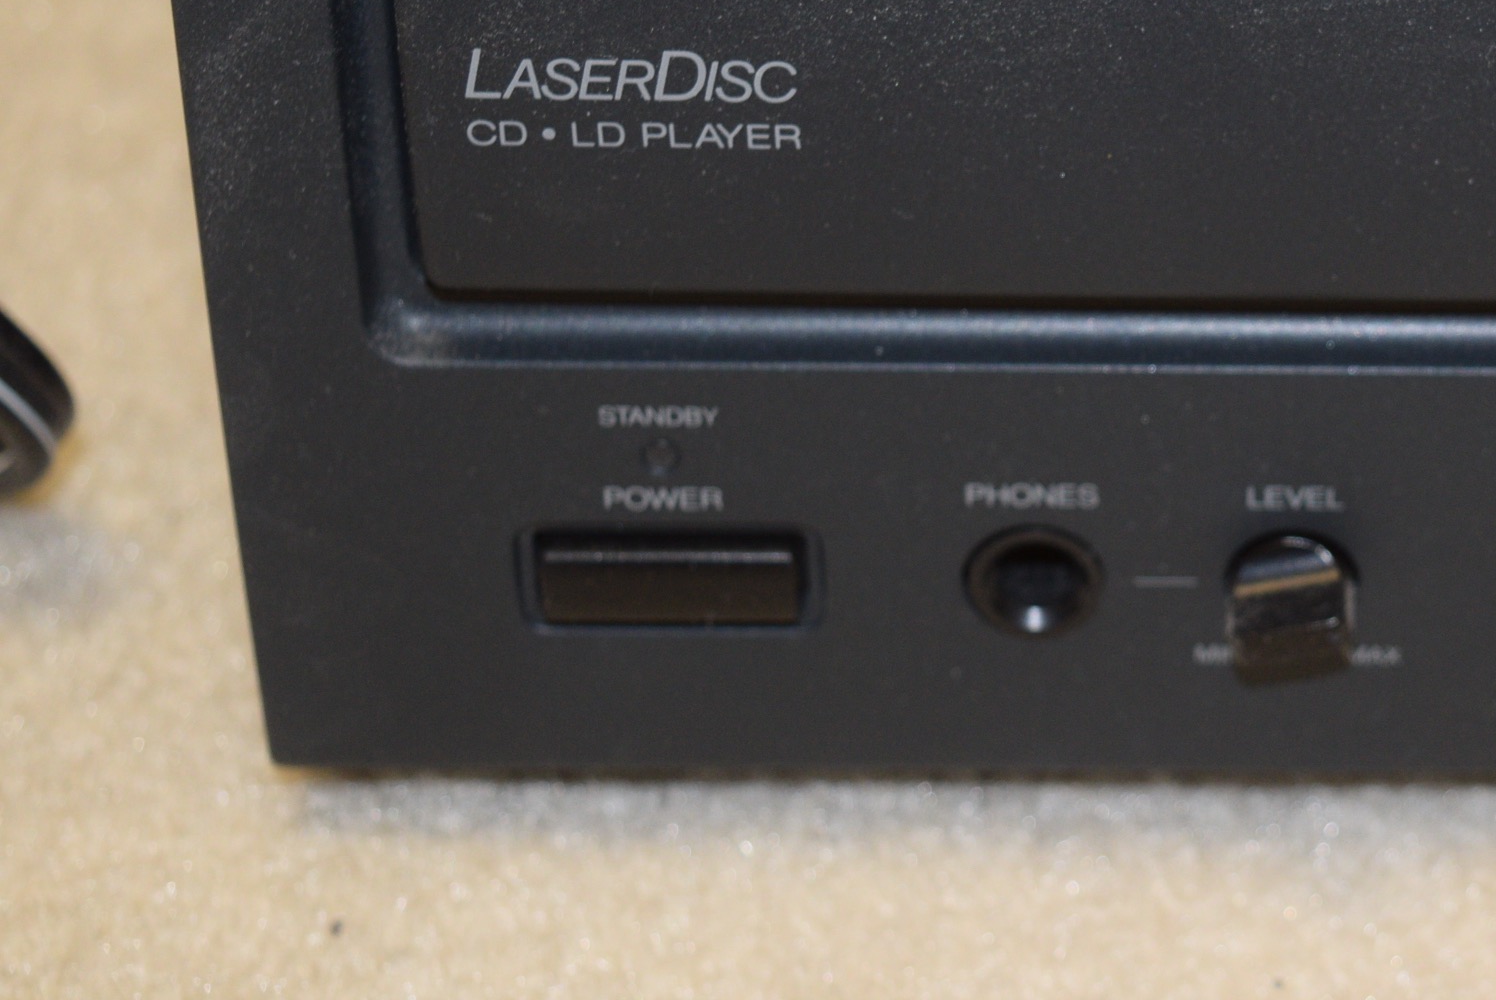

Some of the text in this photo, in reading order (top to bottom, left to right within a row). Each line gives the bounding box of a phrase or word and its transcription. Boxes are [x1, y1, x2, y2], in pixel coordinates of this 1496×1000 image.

[466, 120, 802, 150] CD LD PLAYER
[598, 404, 719, 429] STANDBY
[603, 484, 723, 512] POWER
[965, 481, 1101, 511] PHONES
[1244, 485, 1344, 512] LEVEL
